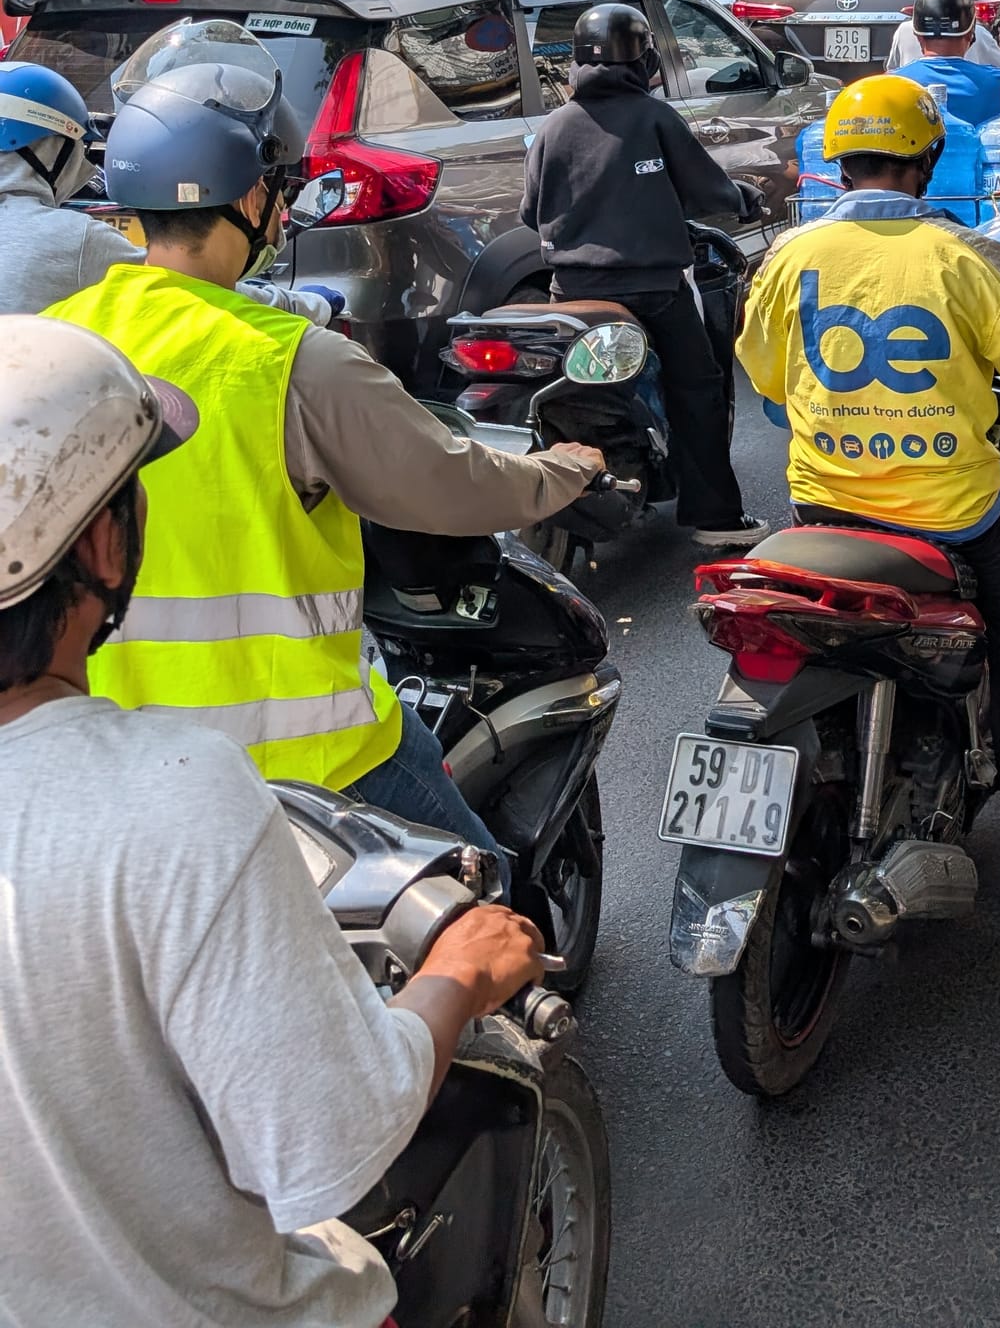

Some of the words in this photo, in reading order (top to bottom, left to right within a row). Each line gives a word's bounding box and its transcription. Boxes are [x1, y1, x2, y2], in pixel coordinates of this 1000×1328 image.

[248, 18, 261, 27] XE
[263, 19, 282, 29] HỢP
[284, 20, 311, 31] ĐỒNG
[835, 30, 859, 44] 51G
[799, 269, 951, 394] be
[811, 402, 829, 417] Bên
[832, 404, 870, 417] nhau
[873, 405, 903, 420] trọn
[907, 404, 955, 418] đường
[940, 639, 976, 649] BLADE
[689, 744, 775, 797] 59-D1
[668, 790, 782, 846] 211.49
